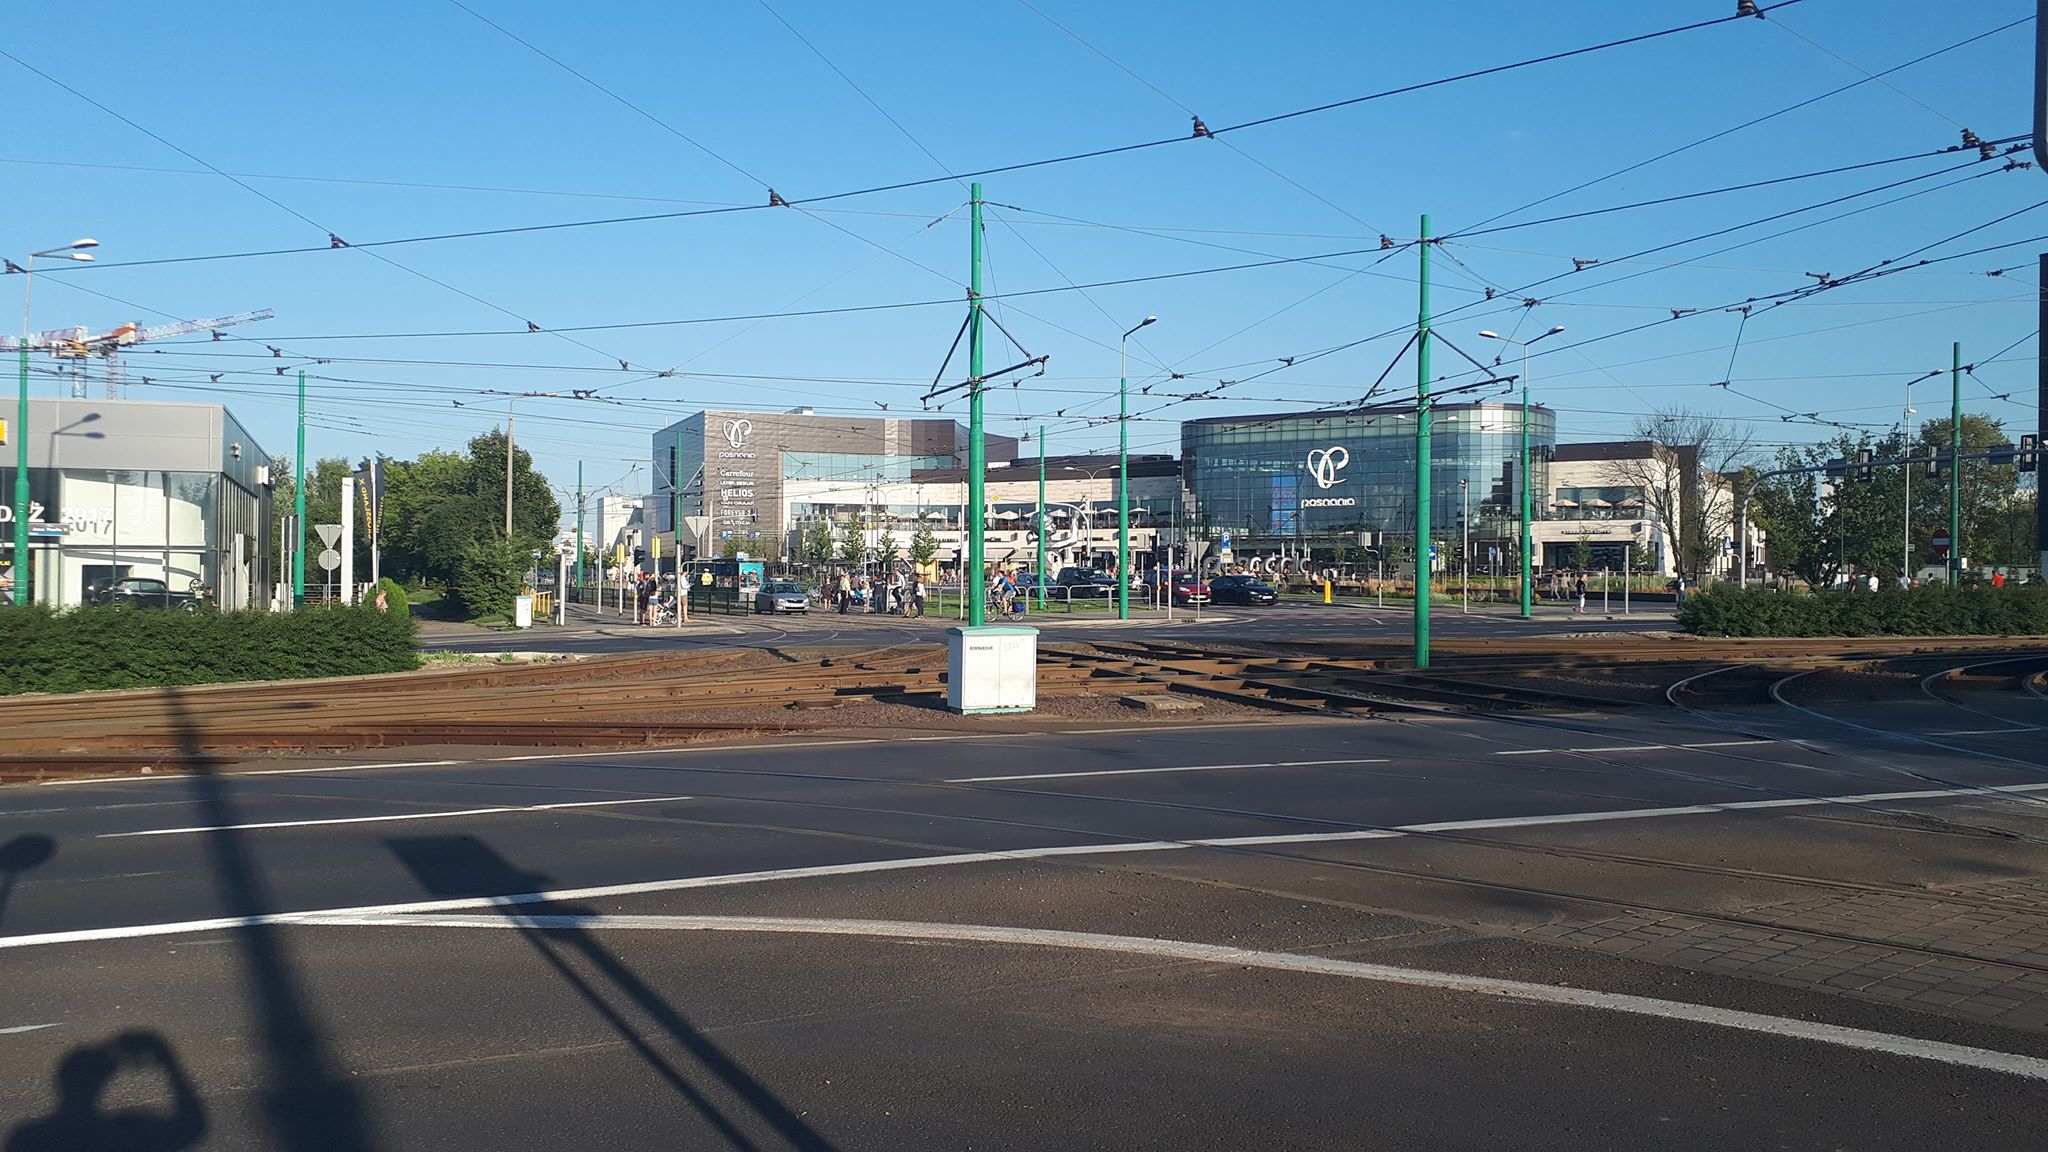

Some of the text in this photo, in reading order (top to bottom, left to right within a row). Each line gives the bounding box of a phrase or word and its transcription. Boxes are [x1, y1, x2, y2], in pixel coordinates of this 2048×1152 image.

[718, 451, 755, 459] posnania
[720, 469, 754, 477] Carrefour
[720, 488, 754, 498] HELIOS
[1301, 497, 1355, 509] posnania
